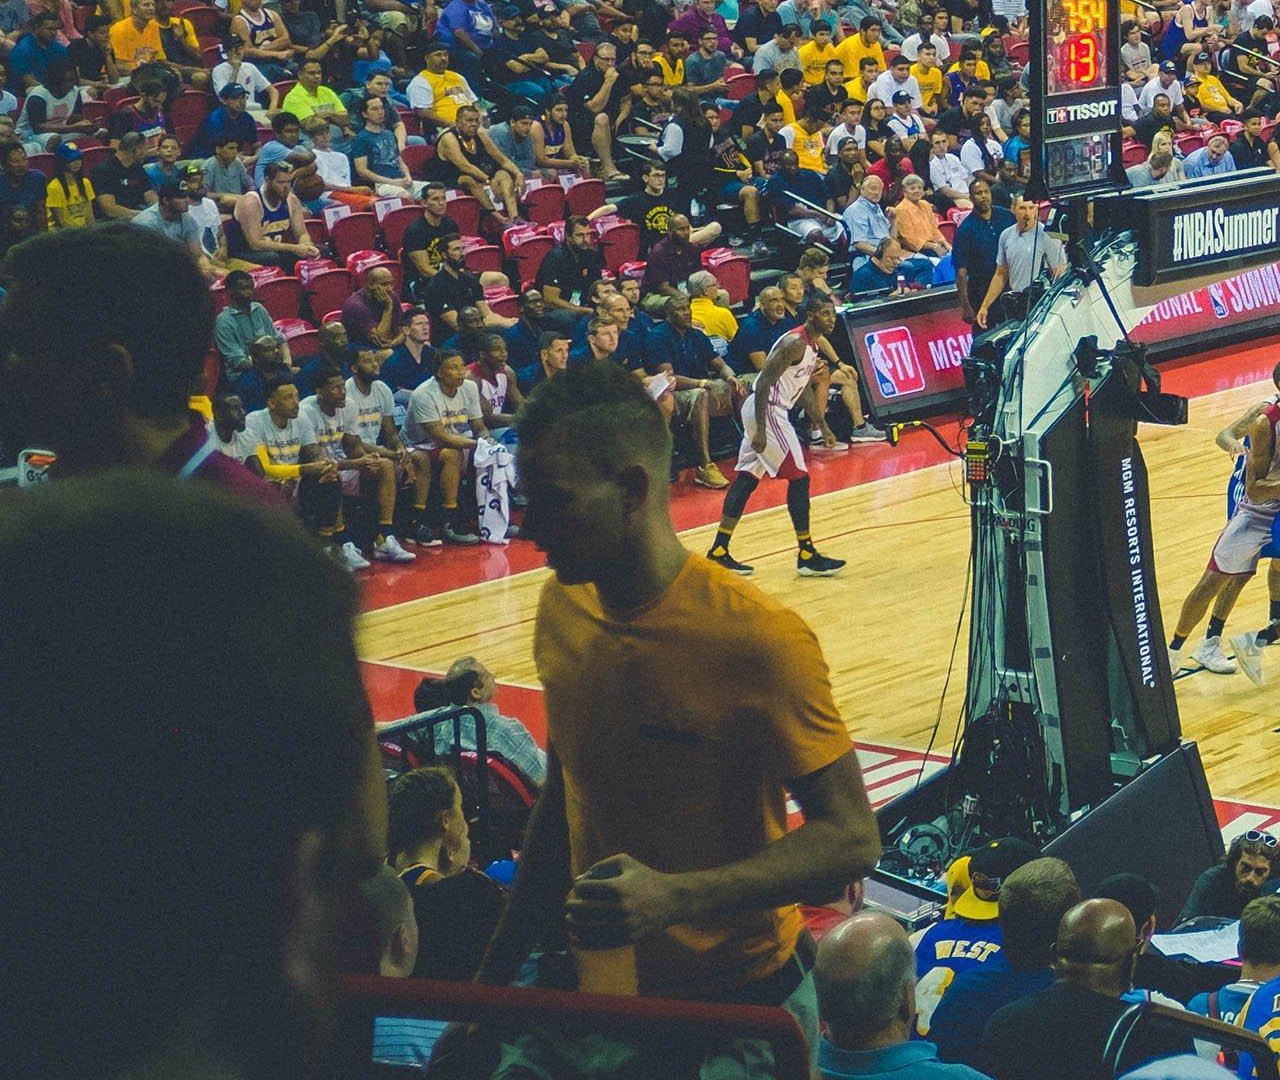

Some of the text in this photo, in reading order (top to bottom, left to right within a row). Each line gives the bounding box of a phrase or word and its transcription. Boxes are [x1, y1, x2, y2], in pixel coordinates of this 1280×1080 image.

[1070, 40, 1096, 83] 13
[1067, 100, 1117, 122] TISSOT
[1173, 207, 1279, 262] #NBASummer
[887, 341, 915, 382] TV
[1121, 457, 1153, 686] MGM RESORTS INTERNATIONAL
[935, 940, 1000, 962] WEST
